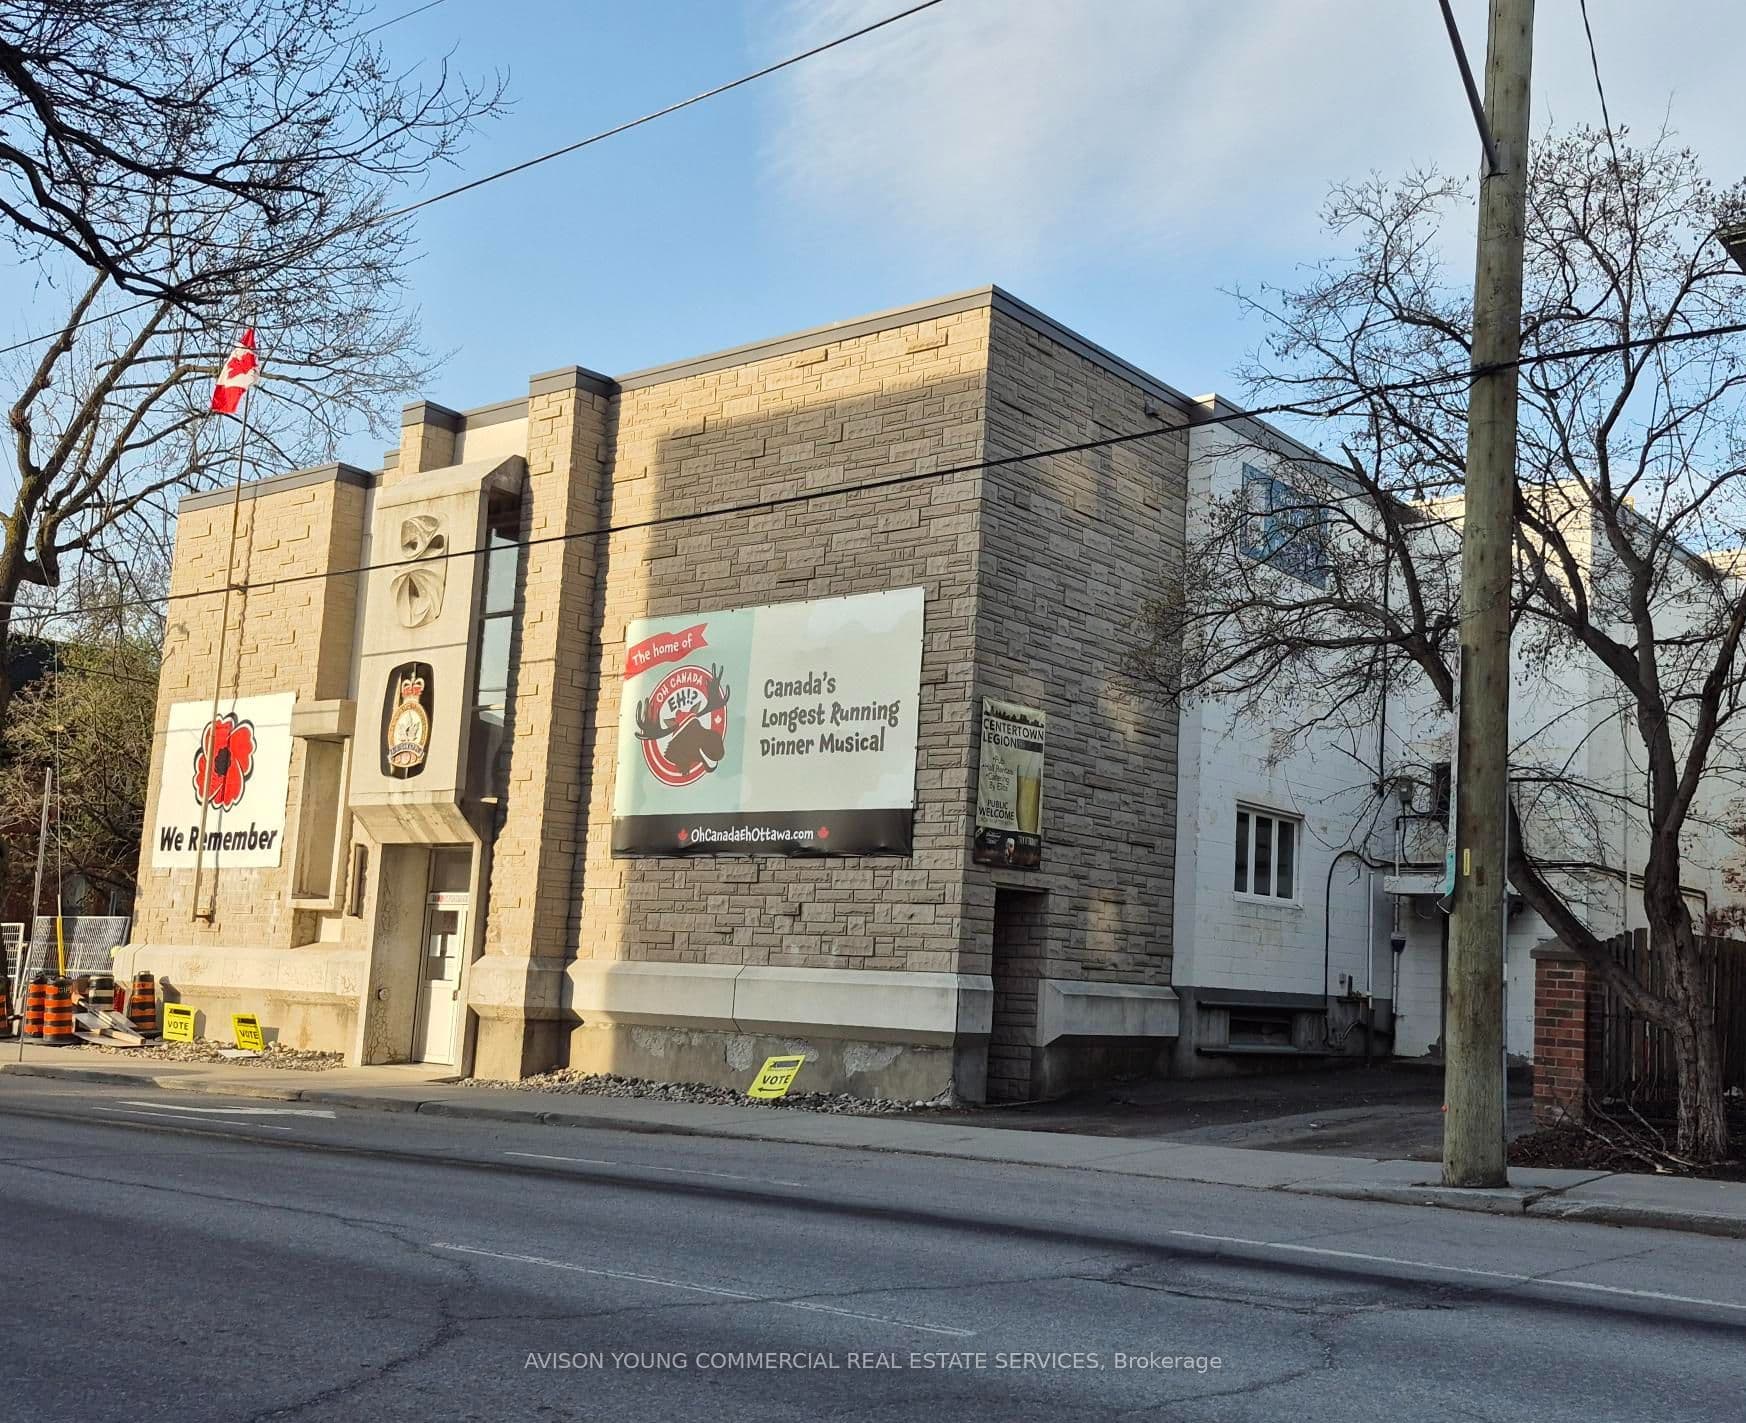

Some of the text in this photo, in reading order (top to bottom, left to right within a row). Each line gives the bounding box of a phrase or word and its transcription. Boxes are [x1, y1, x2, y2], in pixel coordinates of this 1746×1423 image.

[632, 633, 693, 667] The home of
[656, 672, 703, 703] OH CANADA
[764, 671, 836, 699] Canada's
[668, 686, 699, 711] EH!?
[761, 700, 901, 733] Longest Running
[983, 718, 1044, 741] CENTERTOWN
[983, 732, 1018, 749] LEGION
[760, 727, 885, 757] Dinner Musical
[978, 807, 1015, 821] WELCOME
[987, 800, 1009, 810] PUBLIC
[160, 826, 184, 851] We
[691, 826, 814, 843] OhCanadaEhOttawa.com
[167, 1021, 189, 1031] VOTE
[239, 1030, 259, 1040] VOTE
[763, 1074, 791, 1084] VOTE
